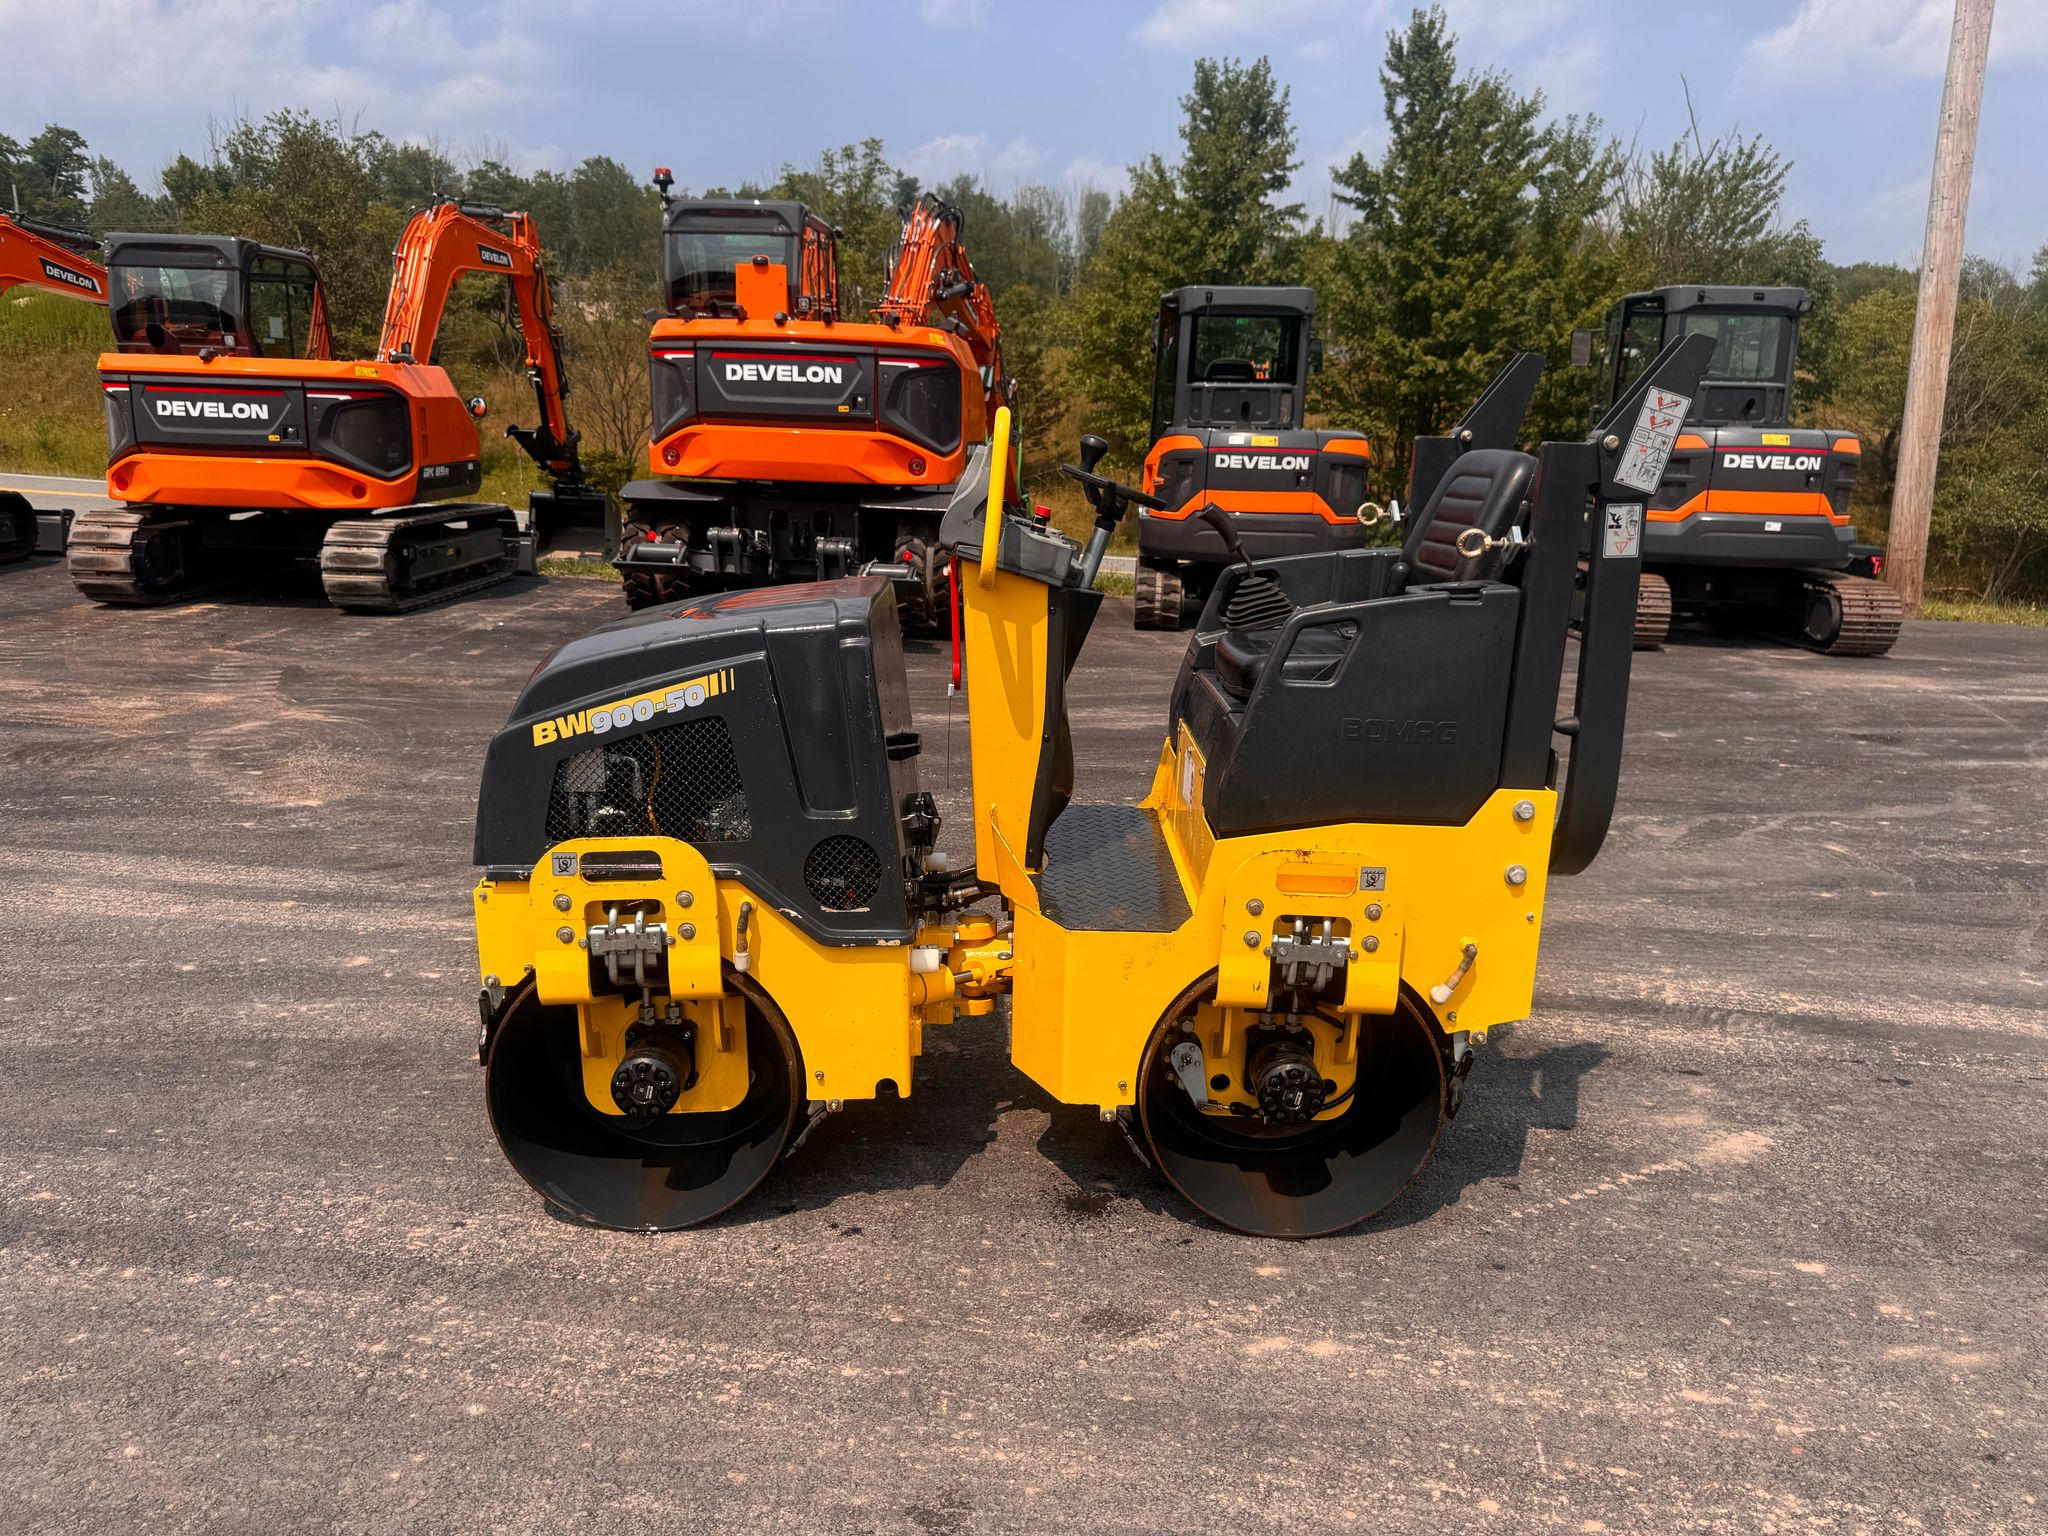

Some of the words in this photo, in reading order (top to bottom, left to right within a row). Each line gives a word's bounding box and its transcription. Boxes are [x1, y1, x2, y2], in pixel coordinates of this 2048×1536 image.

[481, 250, 509, 266] DEVELON
[46, 265, 93, 289] DEVELON
[725, 364, 843, 384] DEVELON
[156, 400, 269, 420] DEVELON
[1214, 454, 1310, 470] DEVELON
[1722, 453, 1822, 471] DEVELON
[1341, 717, 1459, 744] BOMAG
